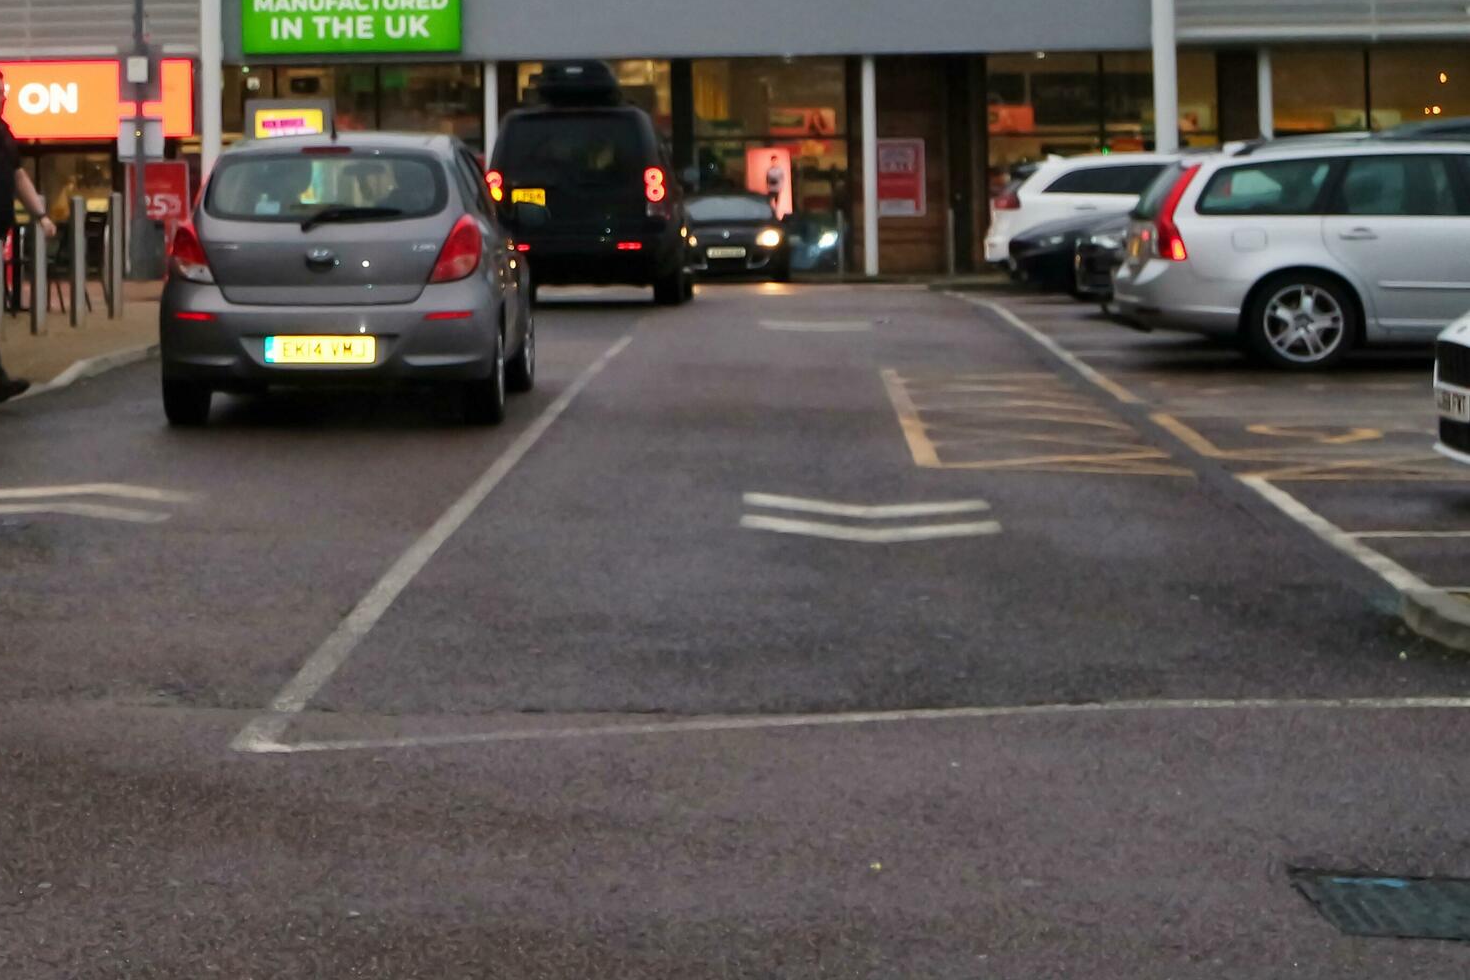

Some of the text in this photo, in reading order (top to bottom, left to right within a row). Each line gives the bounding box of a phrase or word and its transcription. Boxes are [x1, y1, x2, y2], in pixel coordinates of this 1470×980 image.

[270, 15, 430, 40] IN THE UK
[17, 82, 79, 115] ON
